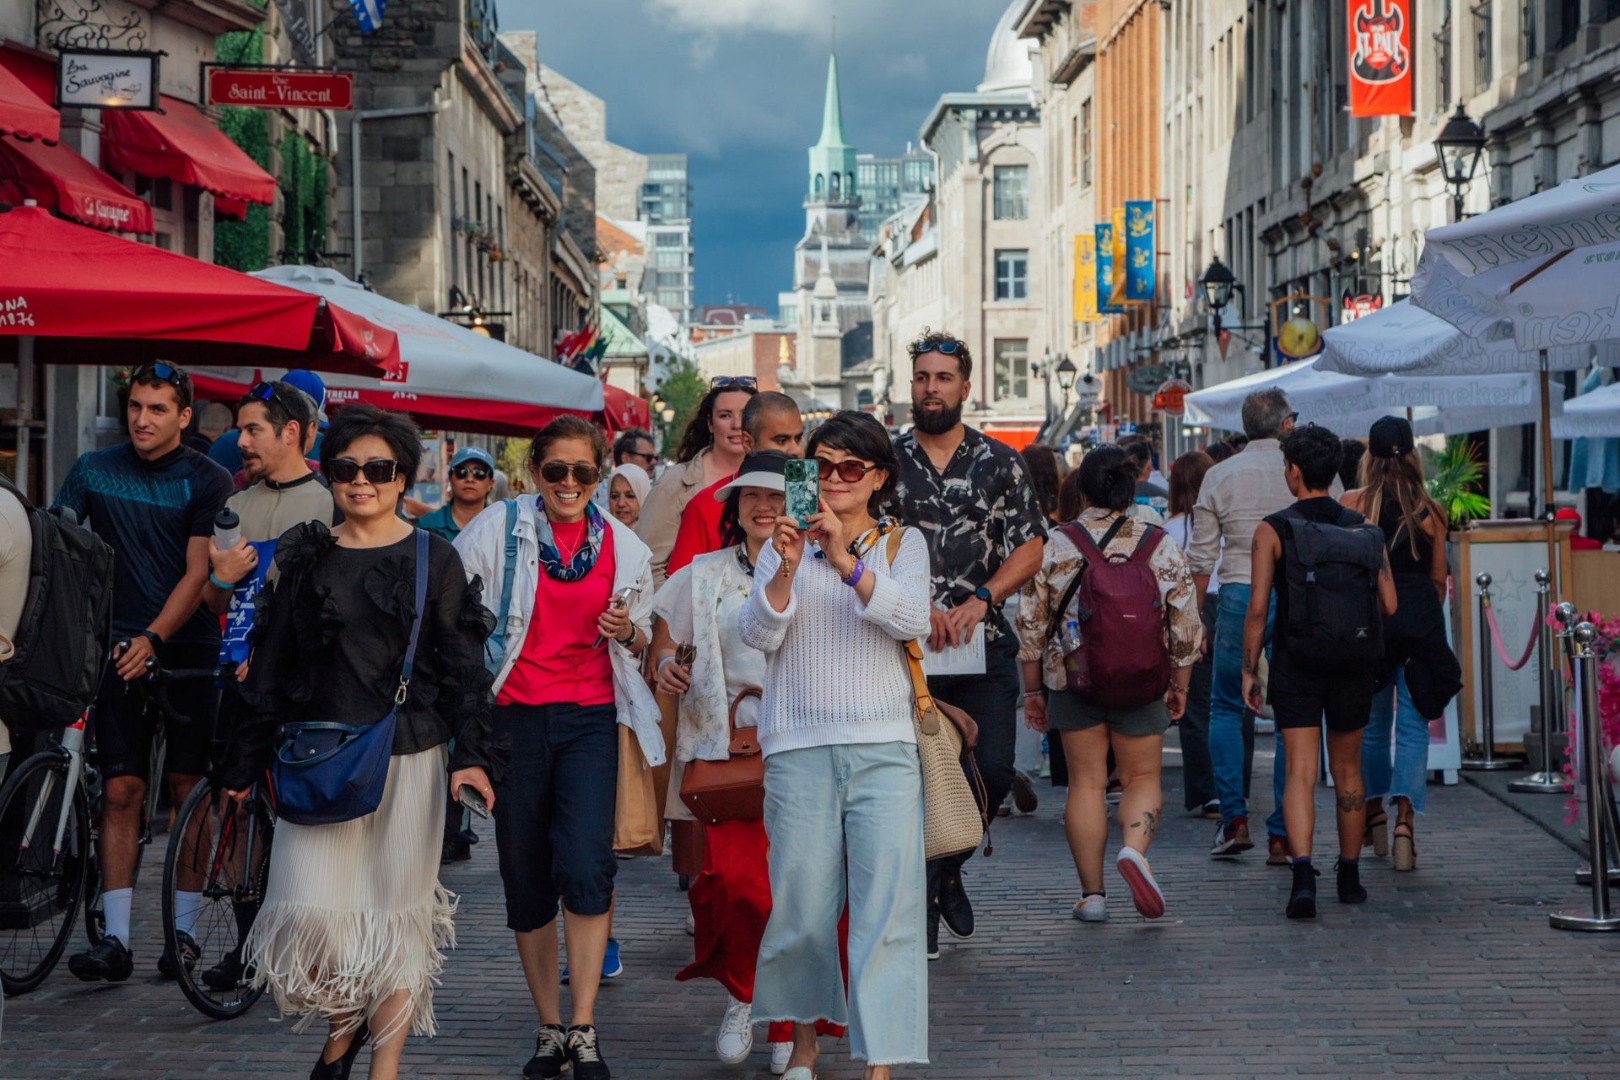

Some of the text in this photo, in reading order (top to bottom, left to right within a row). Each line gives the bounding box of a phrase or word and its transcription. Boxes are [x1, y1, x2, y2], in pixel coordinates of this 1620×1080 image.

[65, 69, 131, 94] Sauvagine
[272, 75, 290, 85] Rue
[228, 83, 332, 103] Saint-Vincent
[1442, 203, 1620, 275] Heine
[1382, 380, 1528, 406] Heineken
